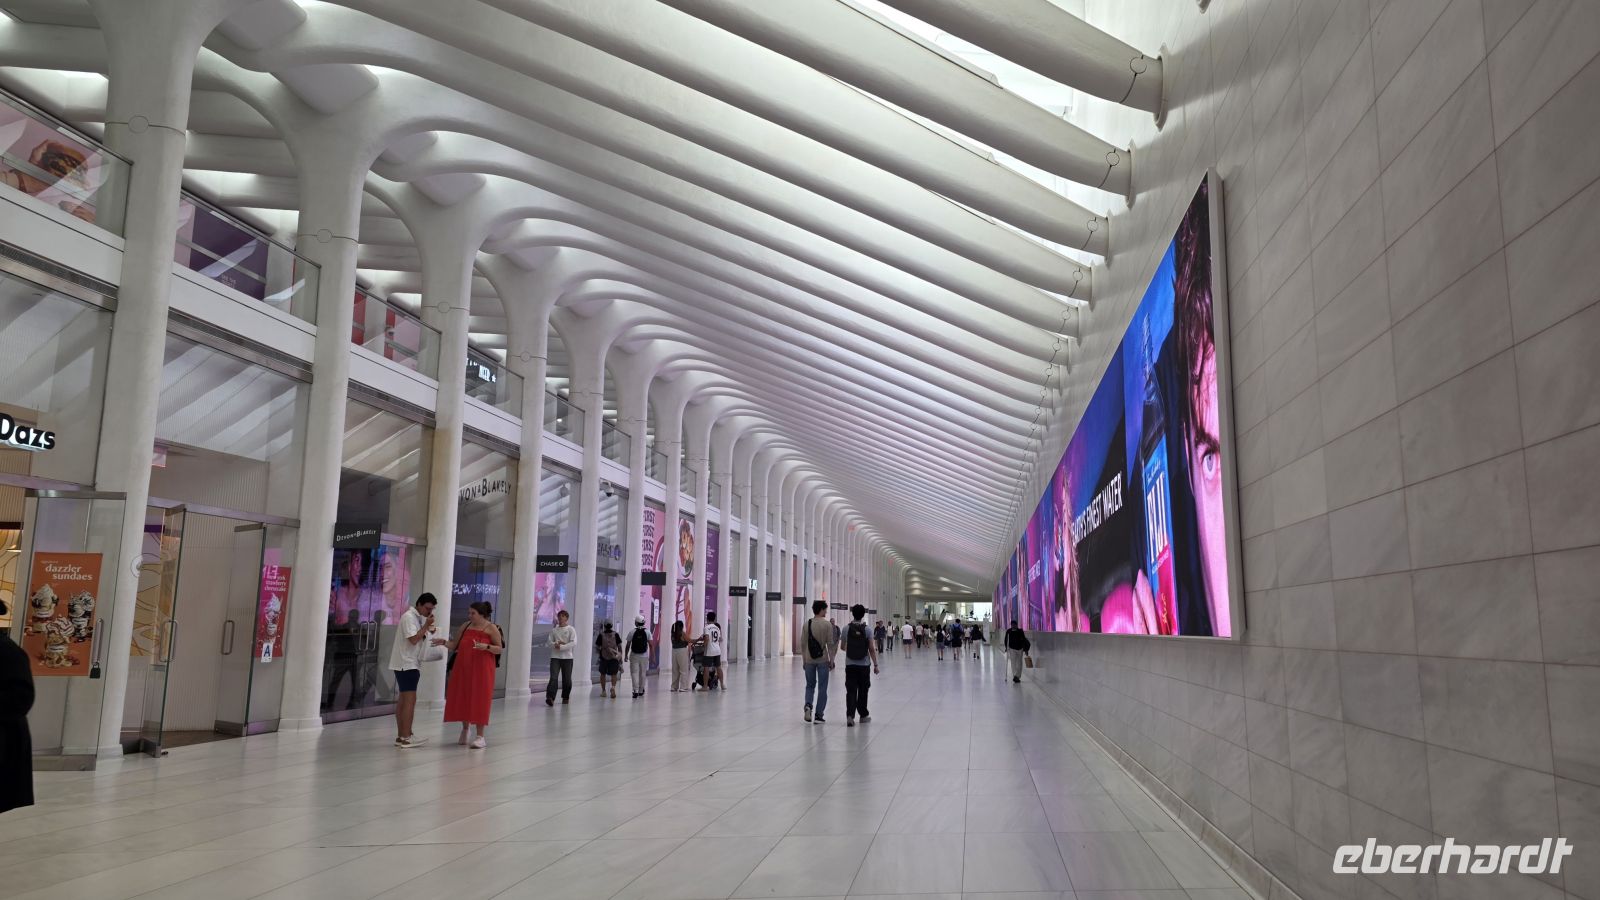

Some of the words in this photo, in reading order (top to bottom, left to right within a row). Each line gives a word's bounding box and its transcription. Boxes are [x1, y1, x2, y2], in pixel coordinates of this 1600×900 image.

[0, 412, 55, 450] Dazs
[1102, 472, 1123, 520] WATER
[45, 564, 82, 573] dazzler
[53, 572, 93, 581] sundaes
[711, 631, 719, 643] 19
[263, 645, 271, 658] A
